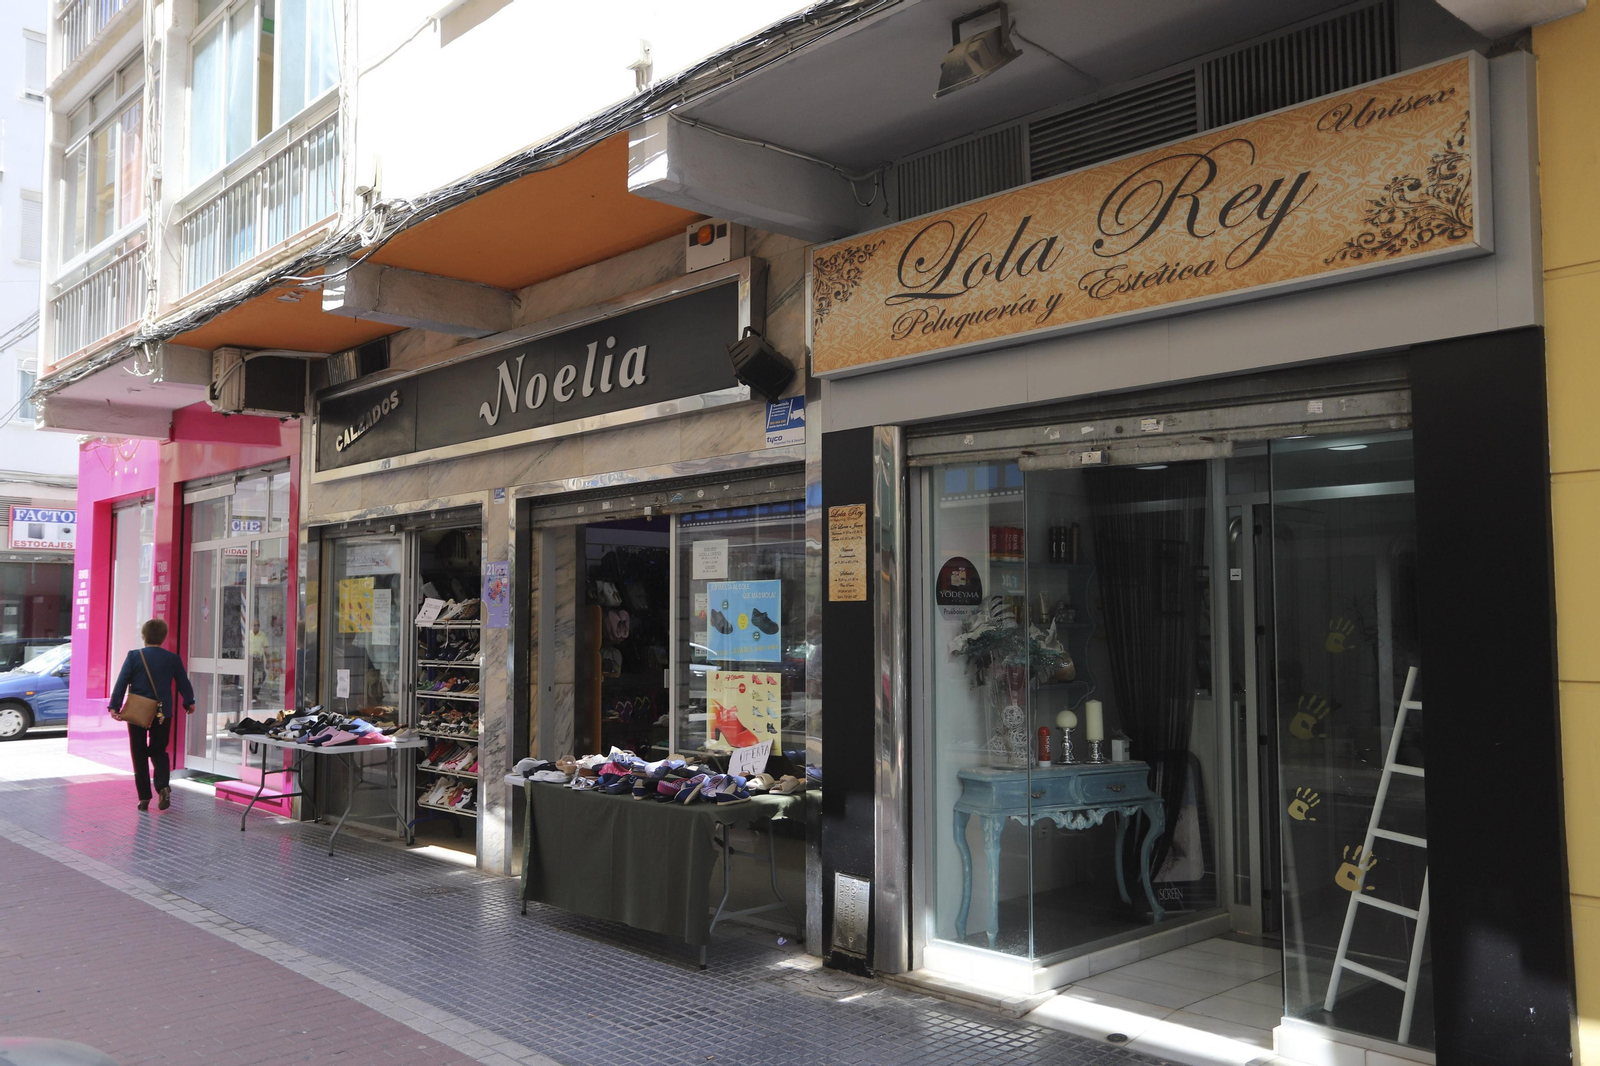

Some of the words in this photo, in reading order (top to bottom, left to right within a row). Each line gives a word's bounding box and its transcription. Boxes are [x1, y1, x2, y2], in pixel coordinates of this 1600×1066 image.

[1317, 87, 1456, 132] Unisex
[885, 212, 1065, 306] Lola
[1092, 138, 1319, 270] Rey
[890, 293, 1040, 341] Peluquería
[1035, 293, 1066, 325] y
[1077, 259, 1219, 301] Estética
[479, 335, 649, 426] Noelia
[336, 390, 399, 452] CALZADOS
[14, 540, 73, 549] ESTOCAJES
[486, 564, 494, 575] 21
[939, 590, 979, 598] YODEYMA
[739, 744, 769, 763] OFERTA
